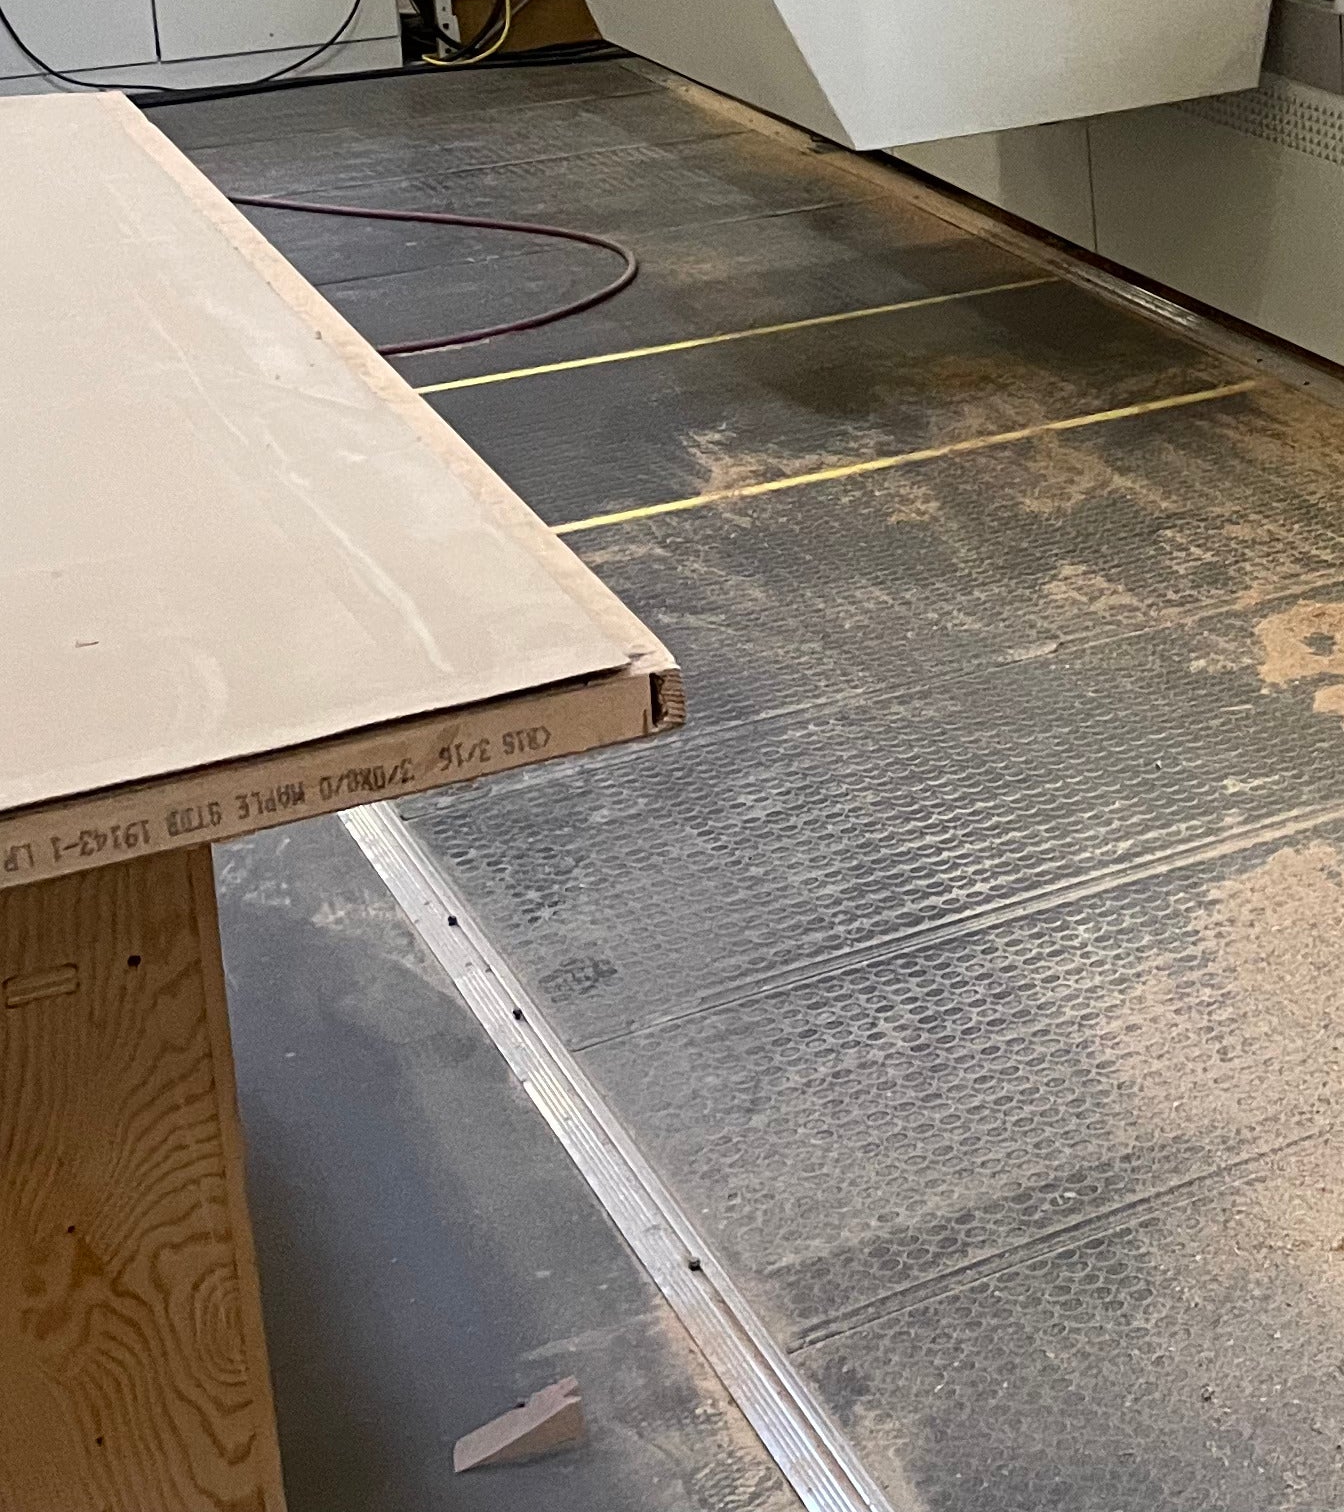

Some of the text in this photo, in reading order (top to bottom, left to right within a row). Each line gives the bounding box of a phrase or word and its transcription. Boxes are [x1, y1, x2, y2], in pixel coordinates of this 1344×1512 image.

[438, 737, 492, 772] 3/16
[234, 780, 307, 820] MAPLE
[49, 818, 152, 863] 19143-1
